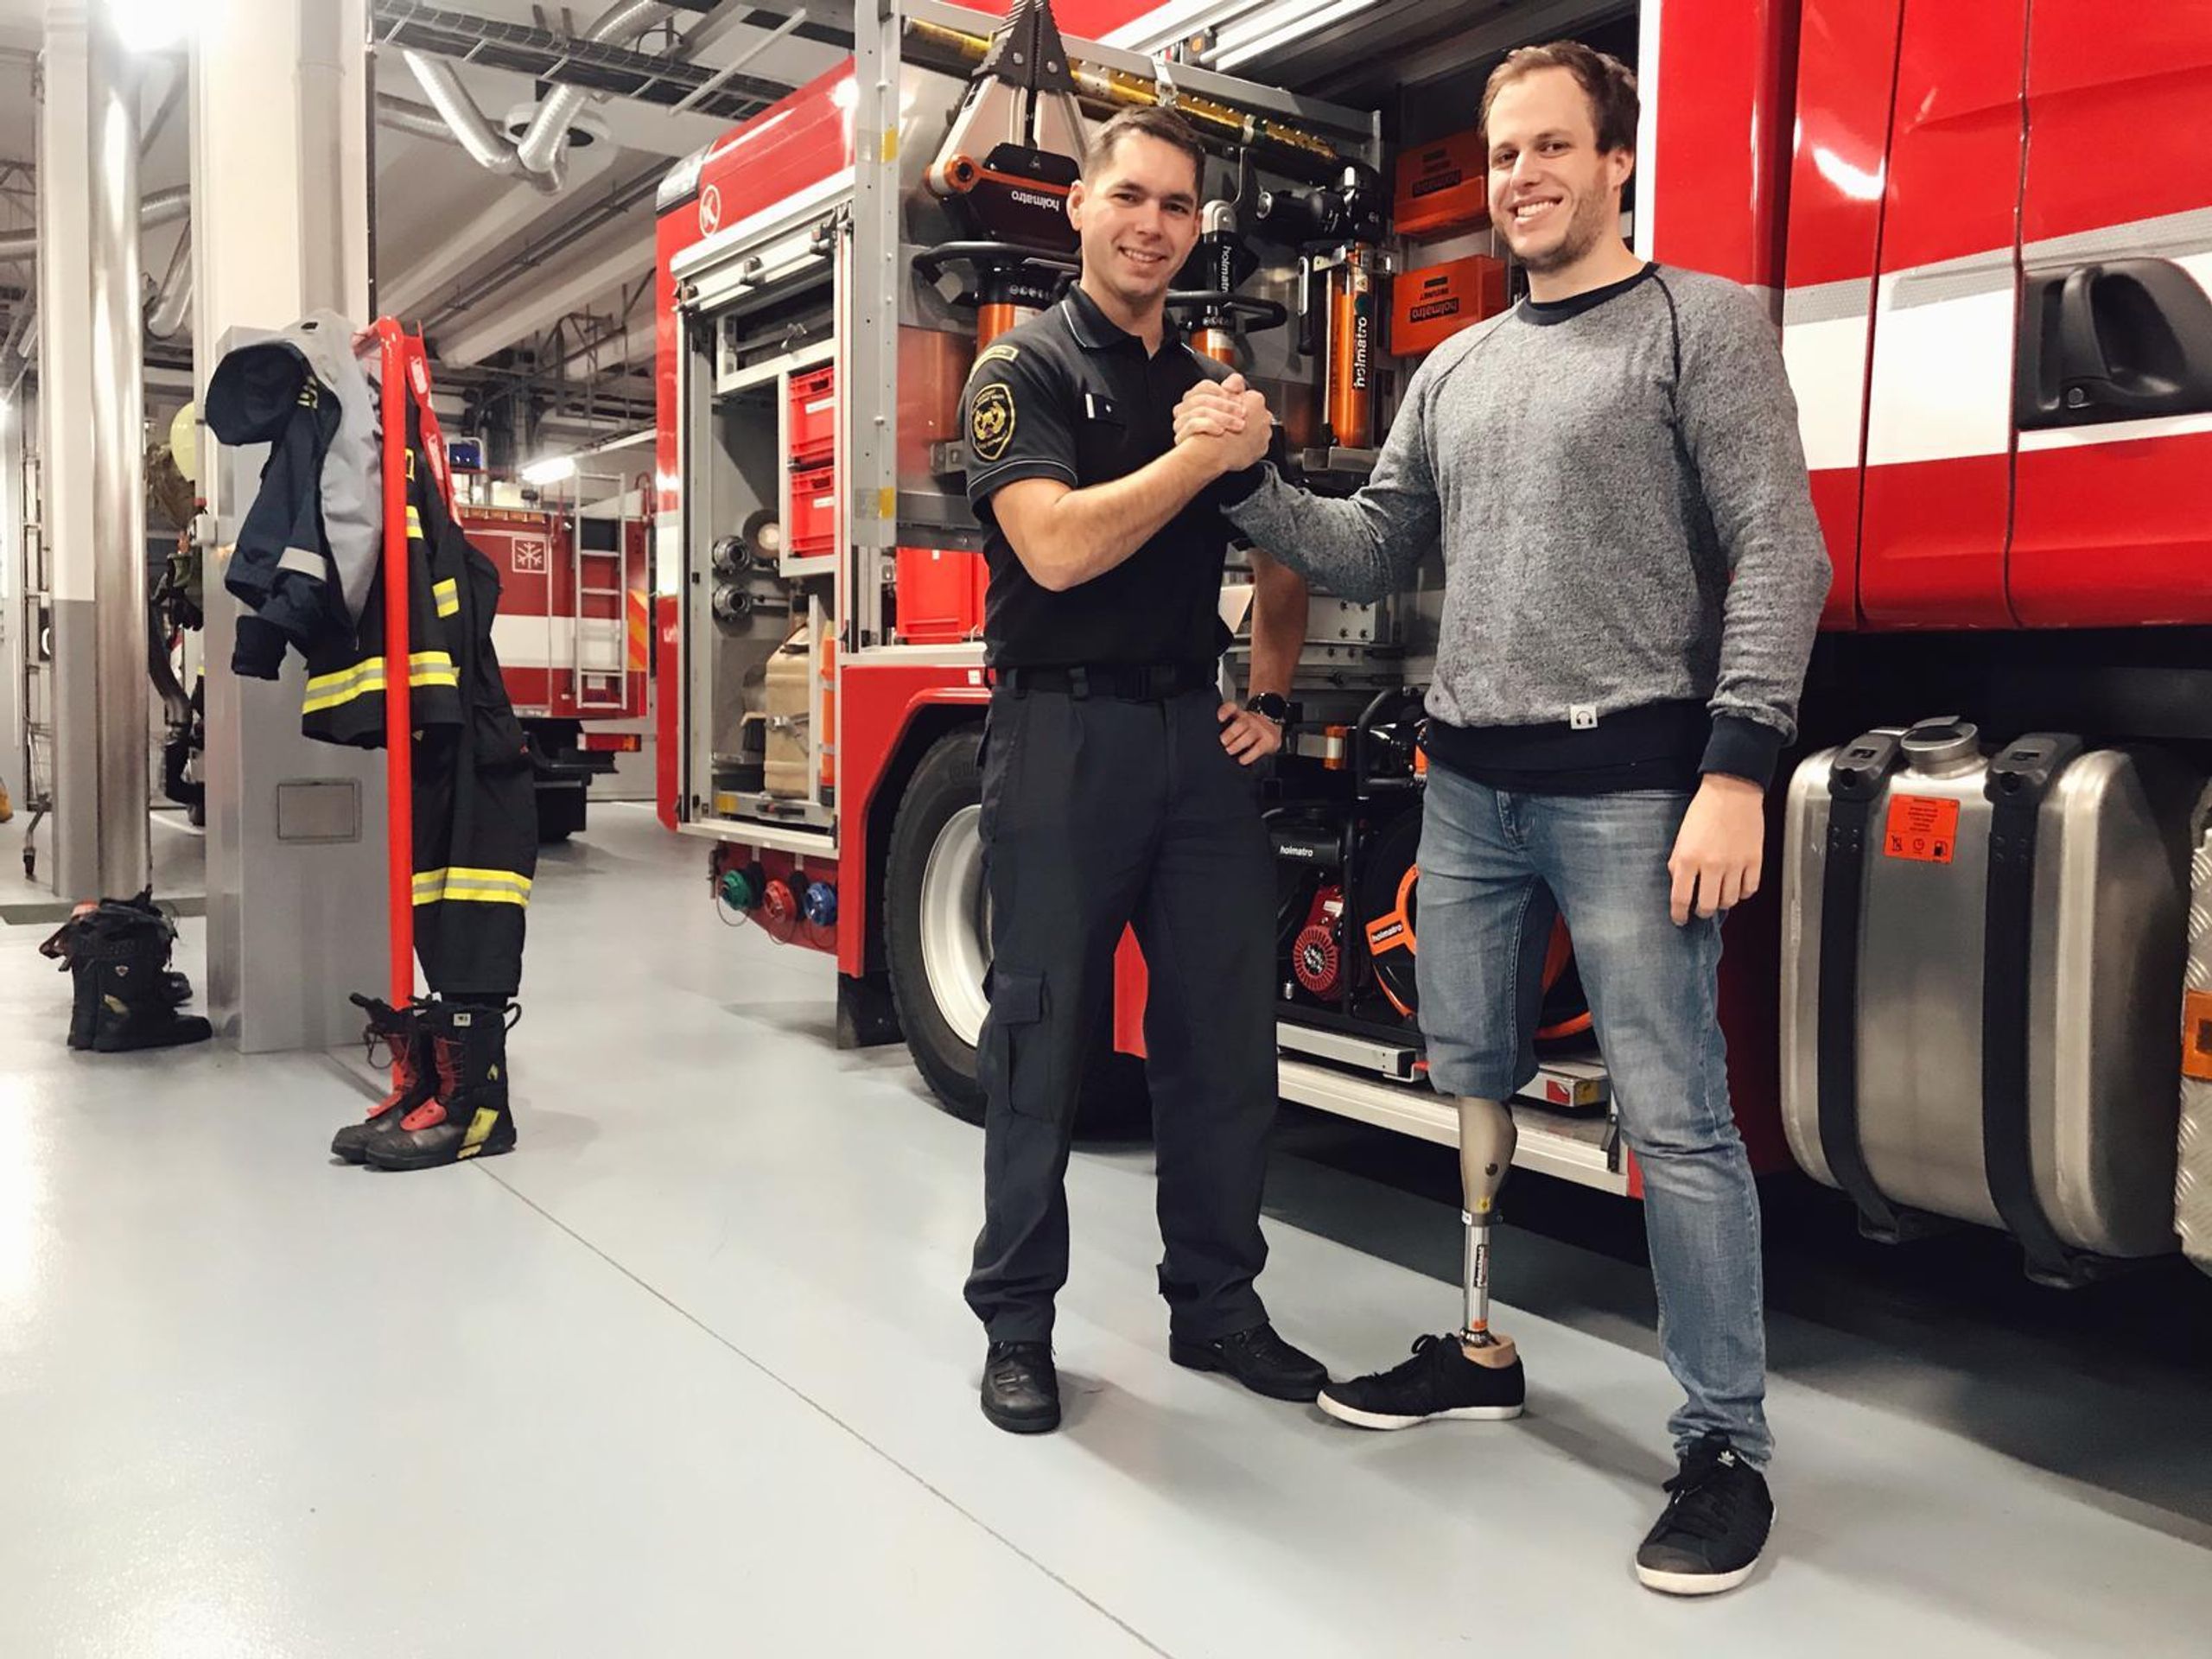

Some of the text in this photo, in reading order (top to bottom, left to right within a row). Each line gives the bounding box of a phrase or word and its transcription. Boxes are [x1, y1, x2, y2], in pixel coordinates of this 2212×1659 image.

[1011, 190, 1060, 212] holmatro
[1221, 245, 1232, 294] holmatr
[1354, 316, 1368, 388] holmatro
[1280, 845, 1313, 857] holmatro
